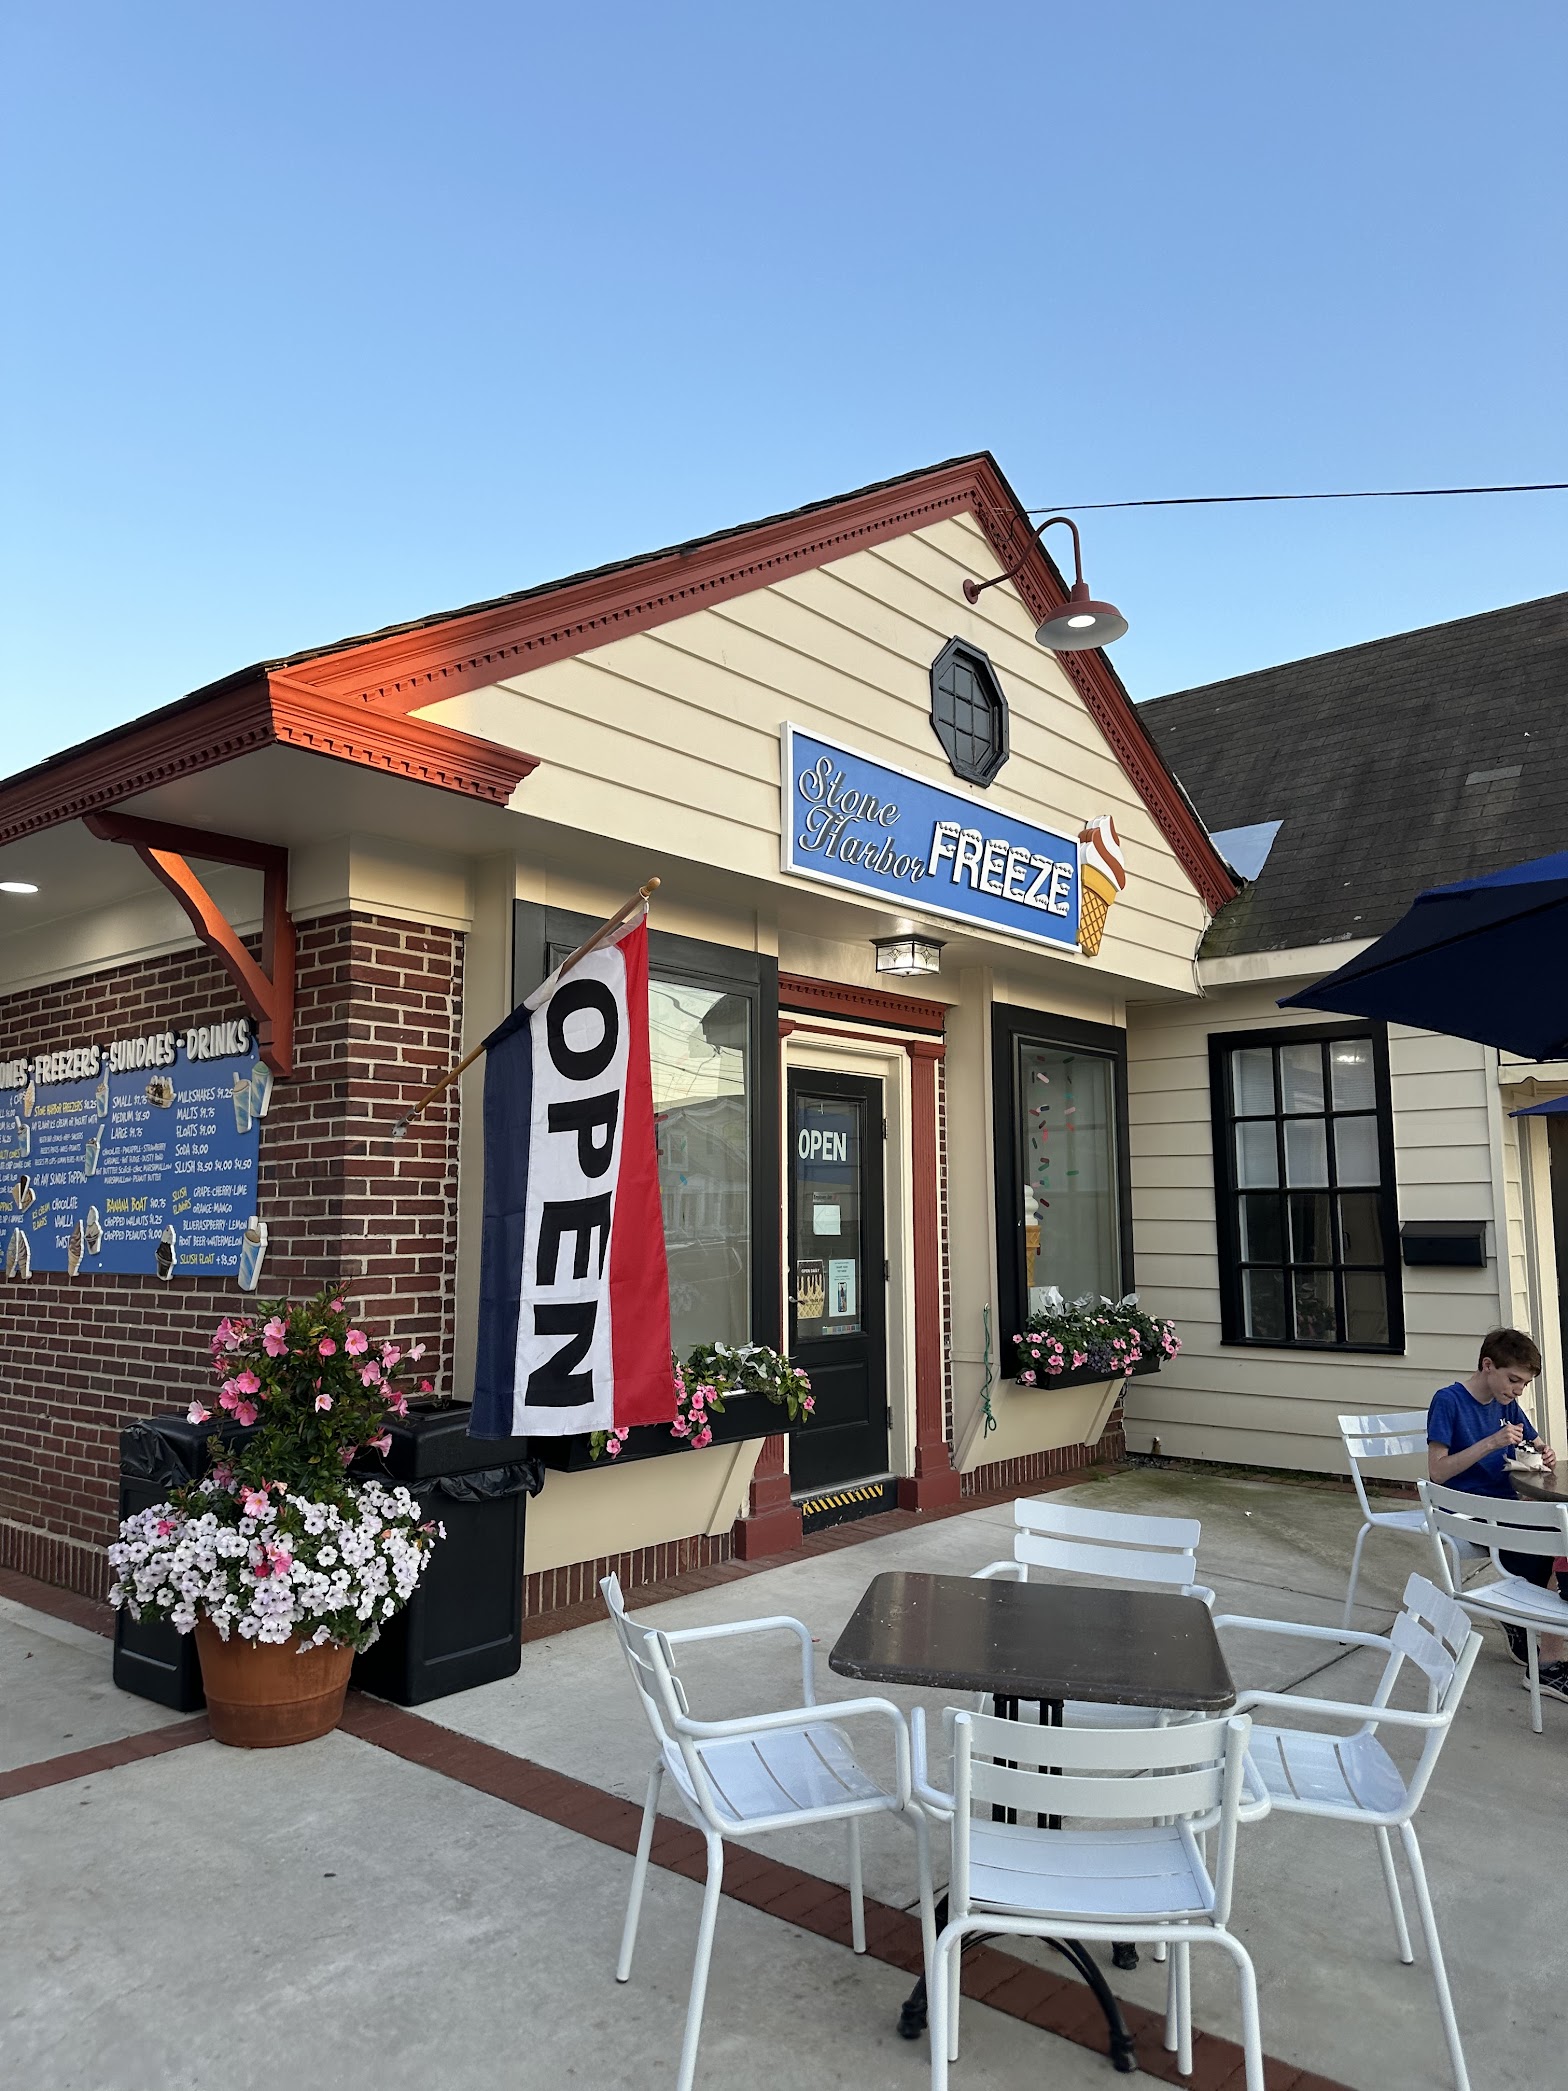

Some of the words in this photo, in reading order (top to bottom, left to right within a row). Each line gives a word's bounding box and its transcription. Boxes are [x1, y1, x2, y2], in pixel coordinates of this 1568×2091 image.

[798, 755, 901, 827] Stone
[798, 805, 925, 884] Harbor
[925, 820, 1075, 918] FREEZE
[35, 1045, 100, 1084] FREEZERS
[109, 1032, 175, 1074] SUNDAES
[186, 1018, 250, 1060] DRINKS
[112, 1095, 132, 1108] SMALL
[177, 1087, 216, 1104] MILKSHAKES
[112, 1111, 134, 1124] MEDIUM
[176, 1106, 198, 1121] MALTS
[111, 1127, 128, 1140] LARGE
[176, 1123, 198, 1138] FLOATS
[175, 1143, 190, 1157] SODA
[798, 1128, 847, 1162] OPEN
[174, 1160, 196, 1174] SLUSH
[214, 1159, 232, 1171] $4.00
[234, 1158, 252, 1170] $4.50
[172, 1186, 188, 1202] SLUSH
[524, 977, 620, 1409] OPEN
[52, 1195, 78, 1210] CHOCOLATE
[106, 1198, 129, 1213] BANANA
[131, 1196, 148, 1212] BOAT
[104, 1216, 125, 1227] CHOPPED
[126, 1214, 149, 1226] WALNUTS
[56, 1235, 71, 1249] TWIST
[104, 1229, 125, 1241] CHOPPED
[125, 1229, 147, 1241] PEANUTS
[179, 1253, 197, 1265] SLUSH
[199, 1253, 215, 1265] FLOAT
